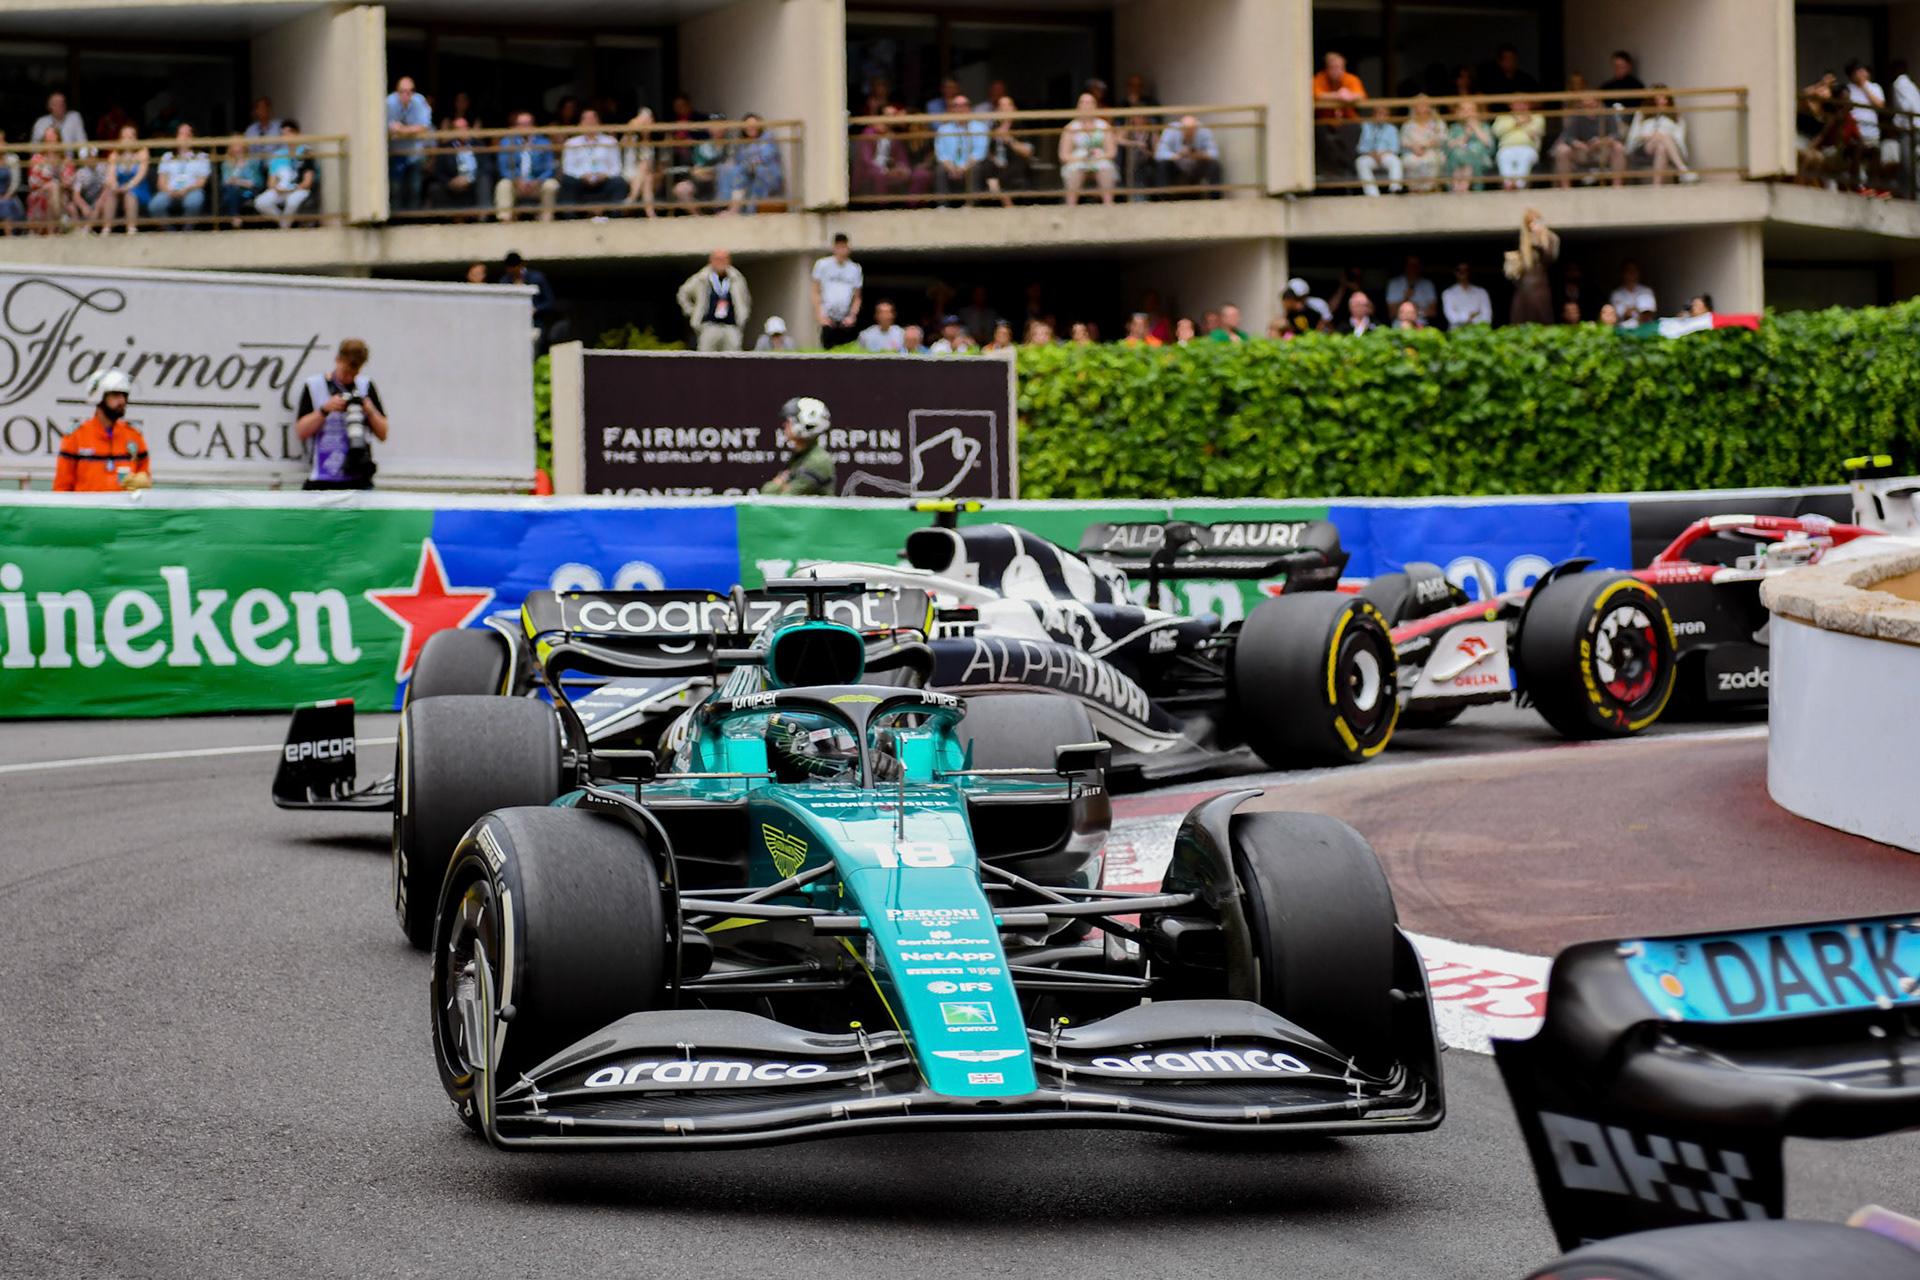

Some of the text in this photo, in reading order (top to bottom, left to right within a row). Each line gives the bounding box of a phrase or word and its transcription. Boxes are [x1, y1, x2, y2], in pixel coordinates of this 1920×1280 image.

[168, 419, 313, 460] CARL
[602, 427, 900, 449] FAIRMONT HIRPIN
[603, 451, 638, 463] THE
[0, 563, 362, 668] ineken
[961, 638, 1150, 722] ALPHATAURI
[863, 842, 955, 868] 18
[885, 908, 979, 918] PERONI
[900, 952, 996, 962] NetApp
[959, 982, 993, 992] IFS
[584, 1060, 829, 1088] aramco
[1091, 1050, 1311, 1074] aramco
[1538, 1111, 1769, 1221] OKX
